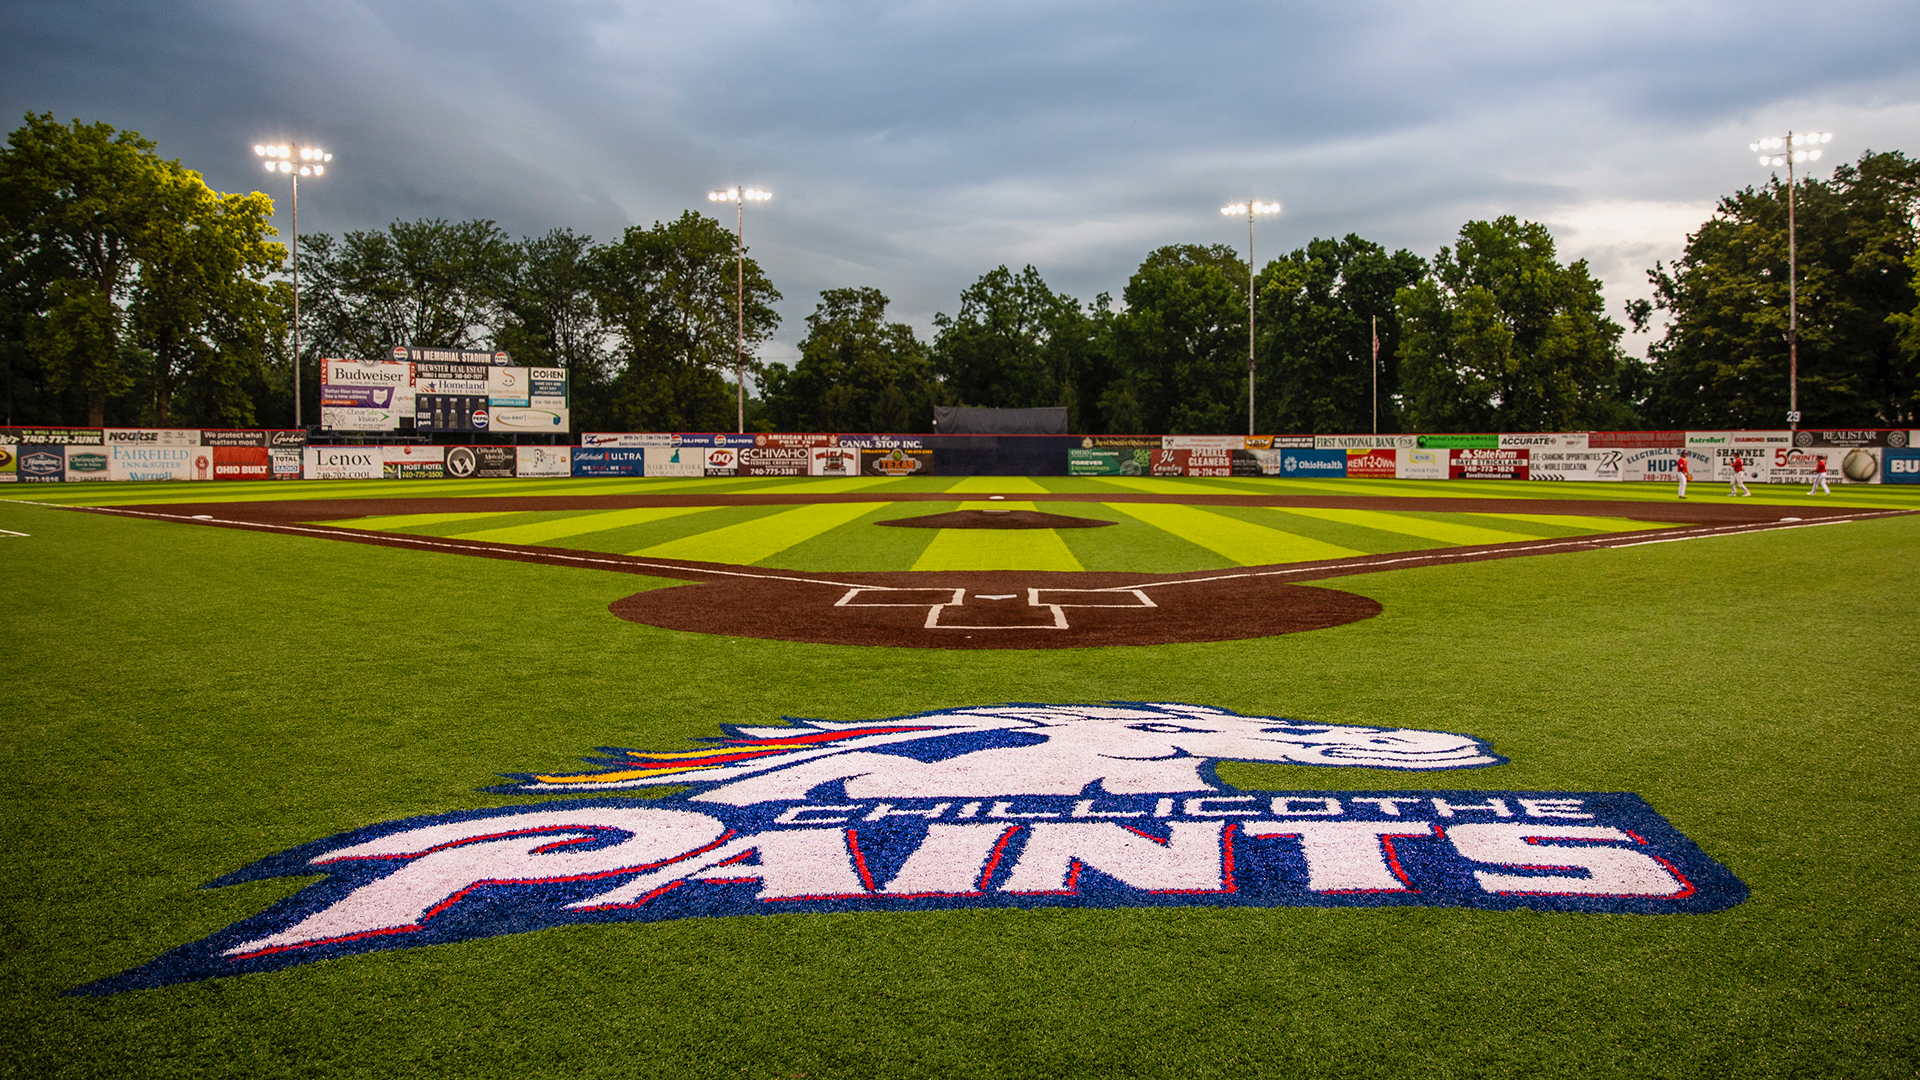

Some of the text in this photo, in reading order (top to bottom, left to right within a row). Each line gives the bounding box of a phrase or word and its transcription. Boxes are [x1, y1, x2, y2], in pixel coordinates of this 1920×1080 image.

[412, 350, 492, 364] VA MEMORIAL STADIUM
[417, 363, 487, 375] BREWSTER REAL ESTATE
[335, 367, 404, 382] Budweiser
[532, 370, 564, 379] COHEN
[439, 380, 485, 390] Homeland
[1786, 410, 1800, 422] 29
[109, 432, 158, 441] NOURSE
[217, 432, 245, 440] protect
[1822, 431, 1877, 440] REALISTAR
[209, 439, 238, 447] matters
[840, 440, 923, 449] CANAL STOP INC.
[1316, 437, 1336, 447] FIRST
[1338, 437, 1374, 447] NATIONAL
[1375, 437, 1396, 447] BANK
[1501, 437, 1550, 446] ACCURATE
[113, 446, 189, 461] FAIRFIELD
[317, 450, 372, 466] Lenox
[611, 453, 642, 461] ULTRA
[713, 453, 731, 463] DQ
[749, 449, 808, 459] CHIVAHO
[1160, 449, 1176, 464] 94
[1190, 449, 1228, 458] SPARKLE
[1530, 453, 1565, 461] LIFE-CHANGING
[1626, 447, 1673, 465] ELECTRICAL
[881, 460, 915, 469] TEXAS
[1188, 457, 1230, 467] CLEANERS
[1298, 460, 1343, 470] OhioHealth
[215, 465, 268, 475] OHIO BUILT
[1770, 468, 1798, 476] HITTING
[769, 793, 1596, 820] CHILLICOTHE
[222, 806, 1697, 960] PAINTS
